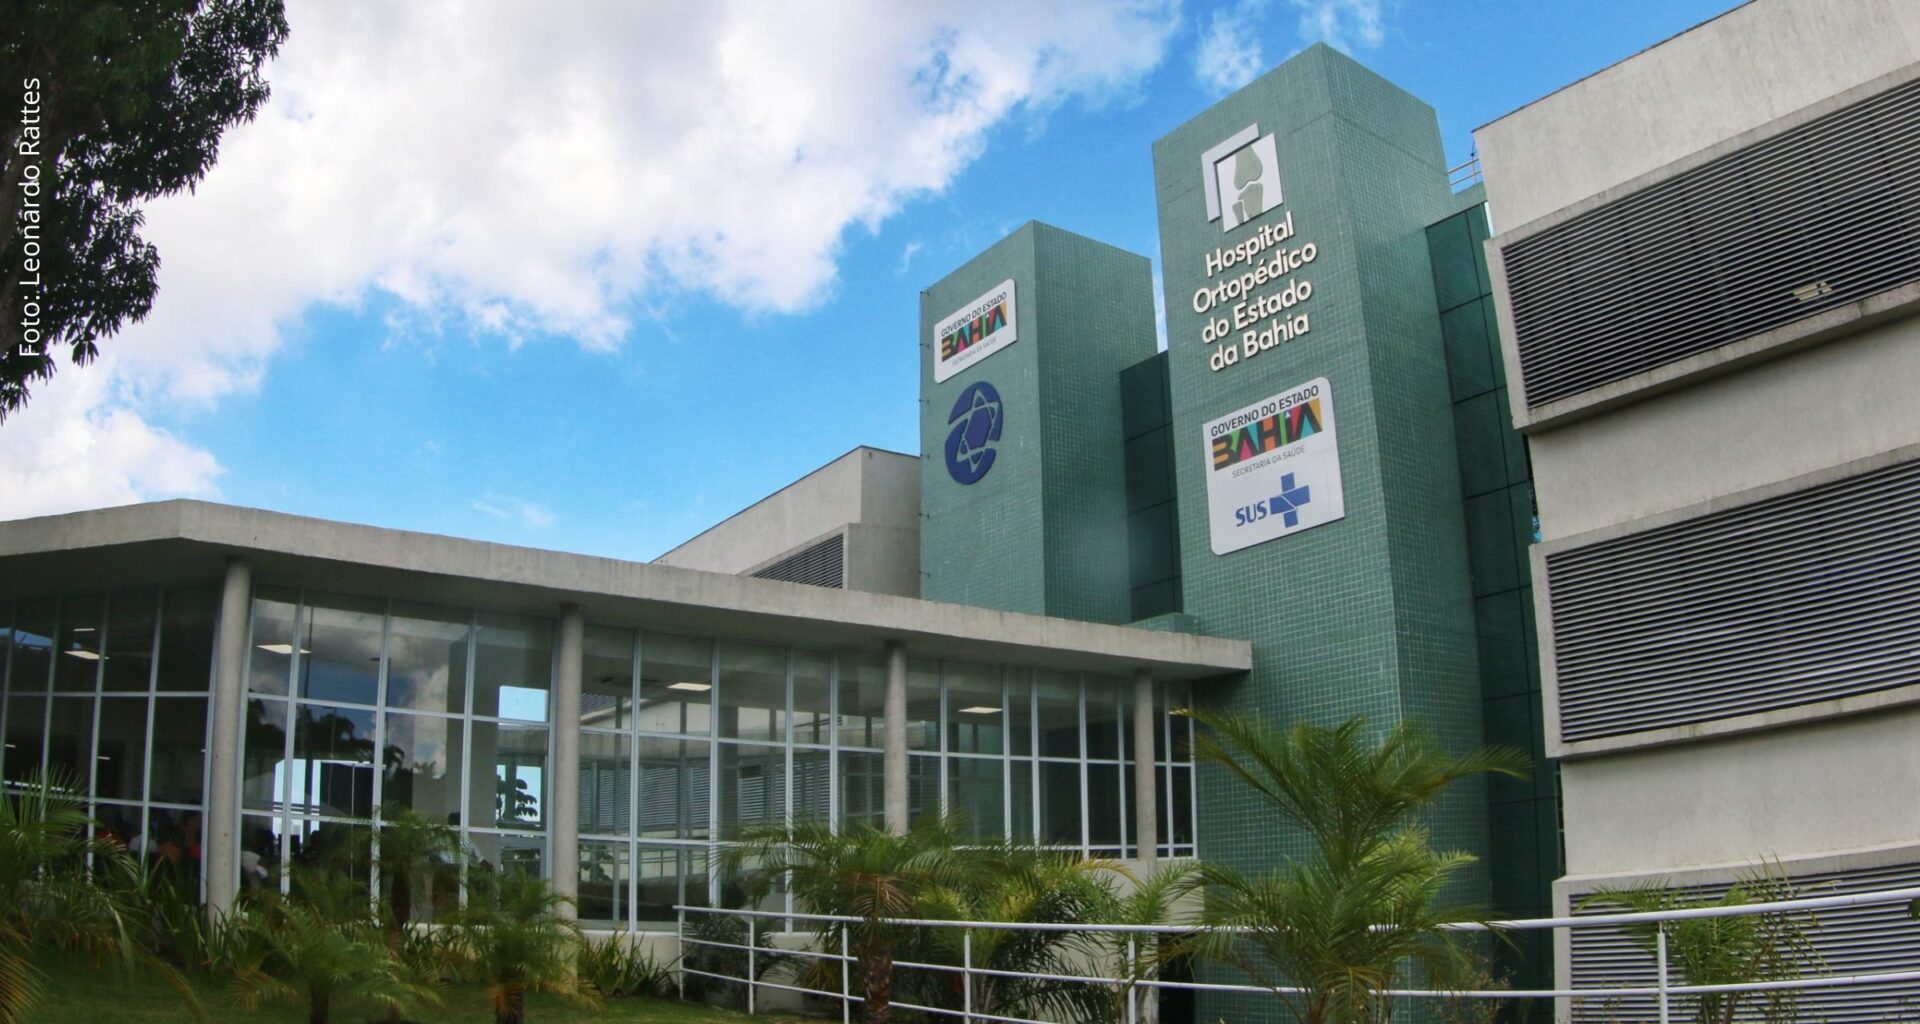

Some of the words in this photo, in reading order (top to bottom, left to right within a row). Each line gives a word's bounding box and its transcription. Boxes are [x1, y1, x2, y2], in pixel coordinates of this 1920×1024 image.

[1205, 210, 1295, 277] Hospital
[1193, 242, 1317, 313] Ortopédico
[941, 313, 971, 337] GOVERNO
[972, 307, 982, 319] DO
[982, 291, 1007, 312] ESTADO
[941, 301, 1007, 363] BAHIA
[1201, 317, 1230, 344] do
[1233, 278, 1312, 330] Estado
[1210, 344, 1239, 372] da
[1243, 313, 1310, 359] Bahia
[1210, 409, 1259, 437] GOVERNO
[1262, 402, 1276, 417] DO
[1279, 385, 1319, 410] ESTADO
[1211, 398, 1323, 471] BAHIA
[1232, 458, 1272, 479] SECRETARIA
[1272, 455, 1282, 464] DA
[1282, 445, 1306, 459] SAÚDE
[1235, 500, 1267, 527] SUS
